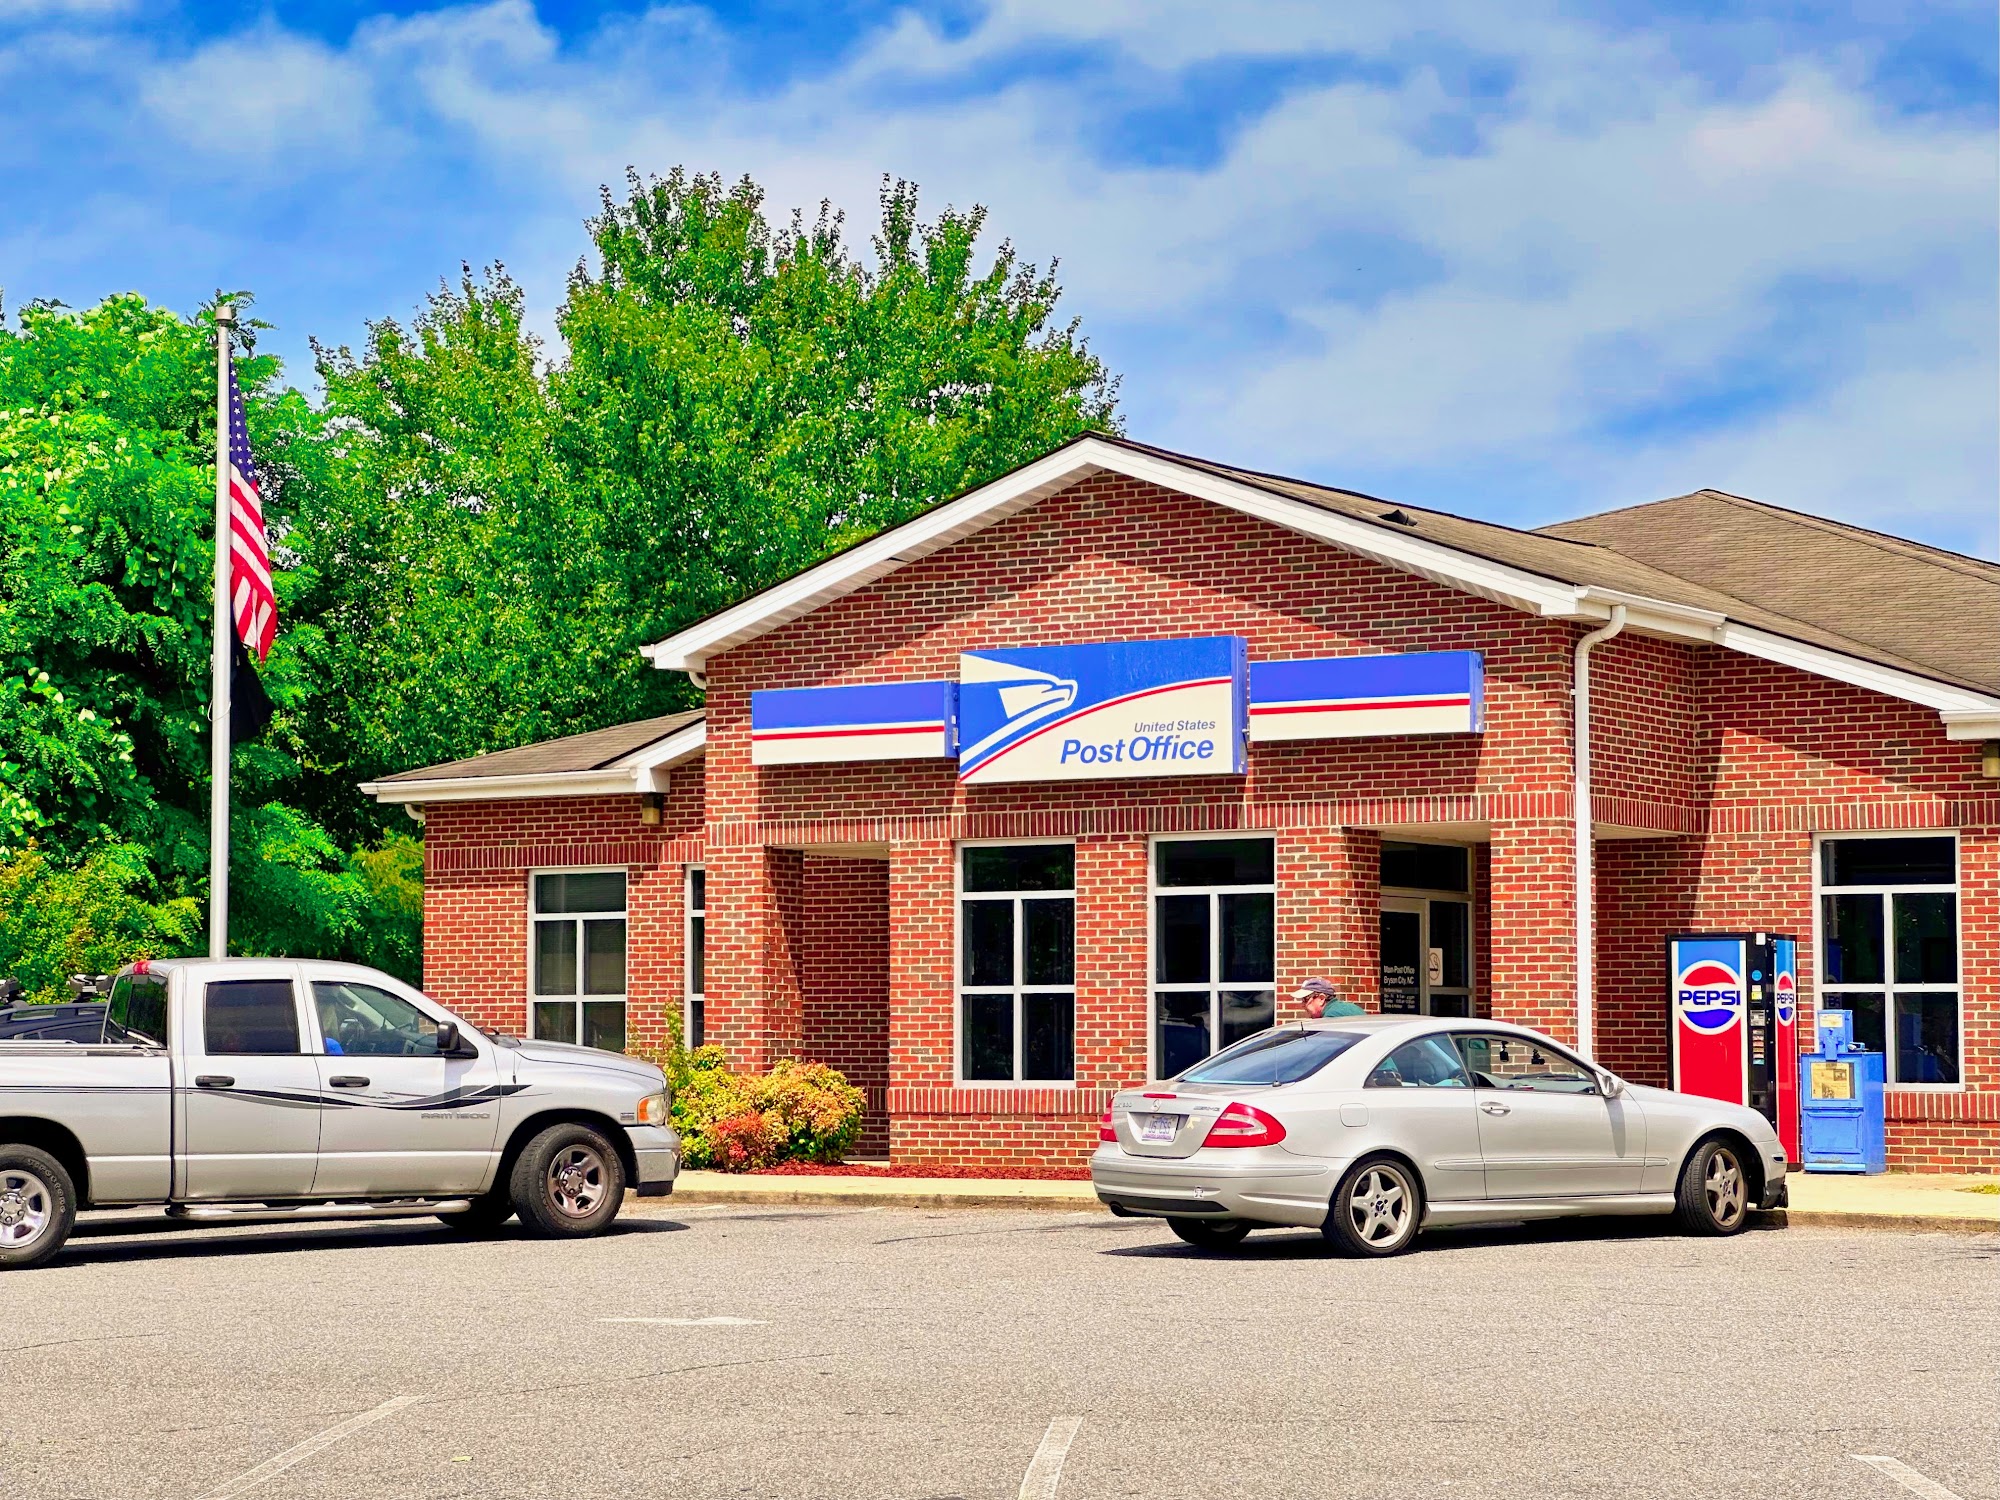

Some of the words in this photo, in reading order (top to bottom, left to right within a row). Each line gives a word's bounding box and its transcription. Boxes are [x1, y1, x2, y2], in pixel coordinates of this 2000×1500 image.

[1134, 721, 1175, 733] United
[1177, 720, 1216, 731] States
[1060, 739, 1126, 764] Post
[1128, 735, 1214, 761] Office
[1394, 966, 1403, 974] Post
[1404, 966, 1415, 974] Office
[1407, 976, 1414, 985] NC
[1679, 990, 1741, 1006] PEPSI
[1777, 992, 1794, 1004] PEPSI
